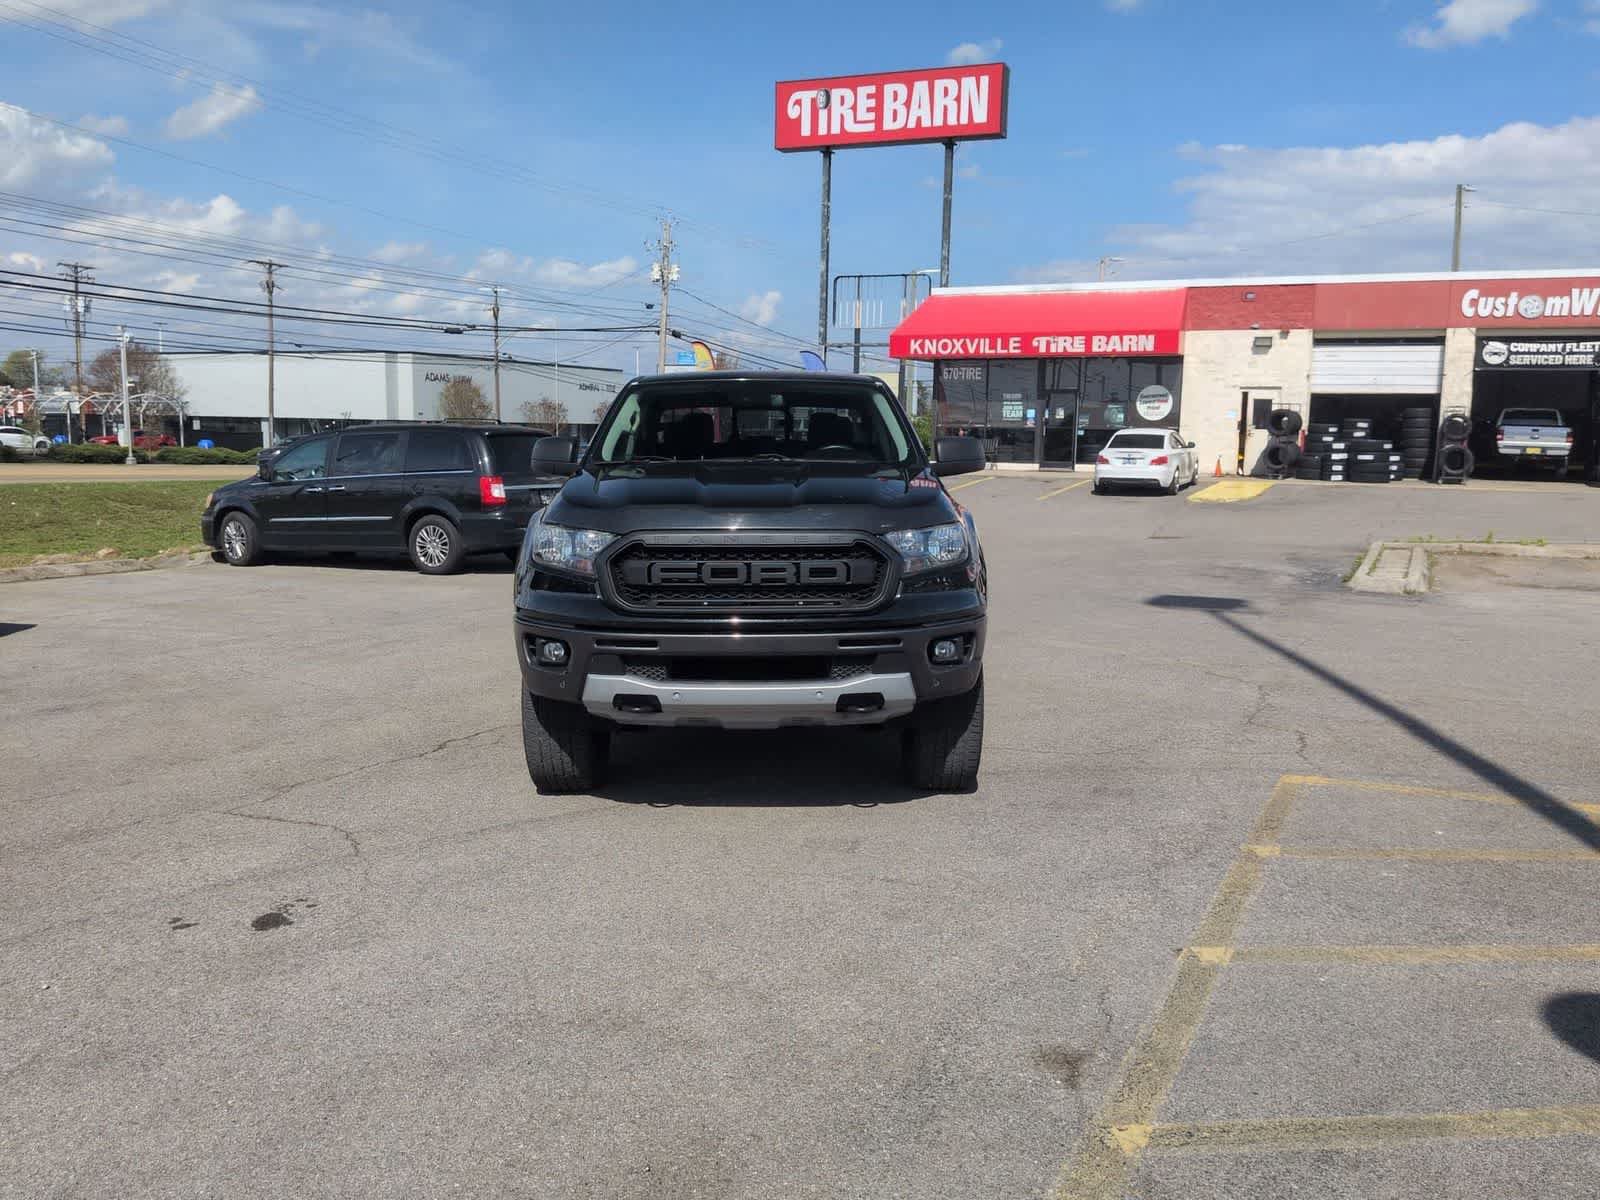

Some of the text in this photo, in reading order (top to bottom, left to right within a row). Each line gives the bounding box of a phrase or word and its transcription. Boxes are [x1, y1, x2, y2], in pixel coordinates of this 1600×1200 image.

[883, 75, 989, 131] BARN
[1461, 287, 1600, 318] CustomW
[909, 336, 1022, 355] KNOXVILLE
[1091, 334, 1155, 353] BARN
[1509, 341, 1600, 353] COMPANY FLEET
[1508, 354, 1594, 366] SERVICED HERE
[648, 560, 849, 586] FORD
